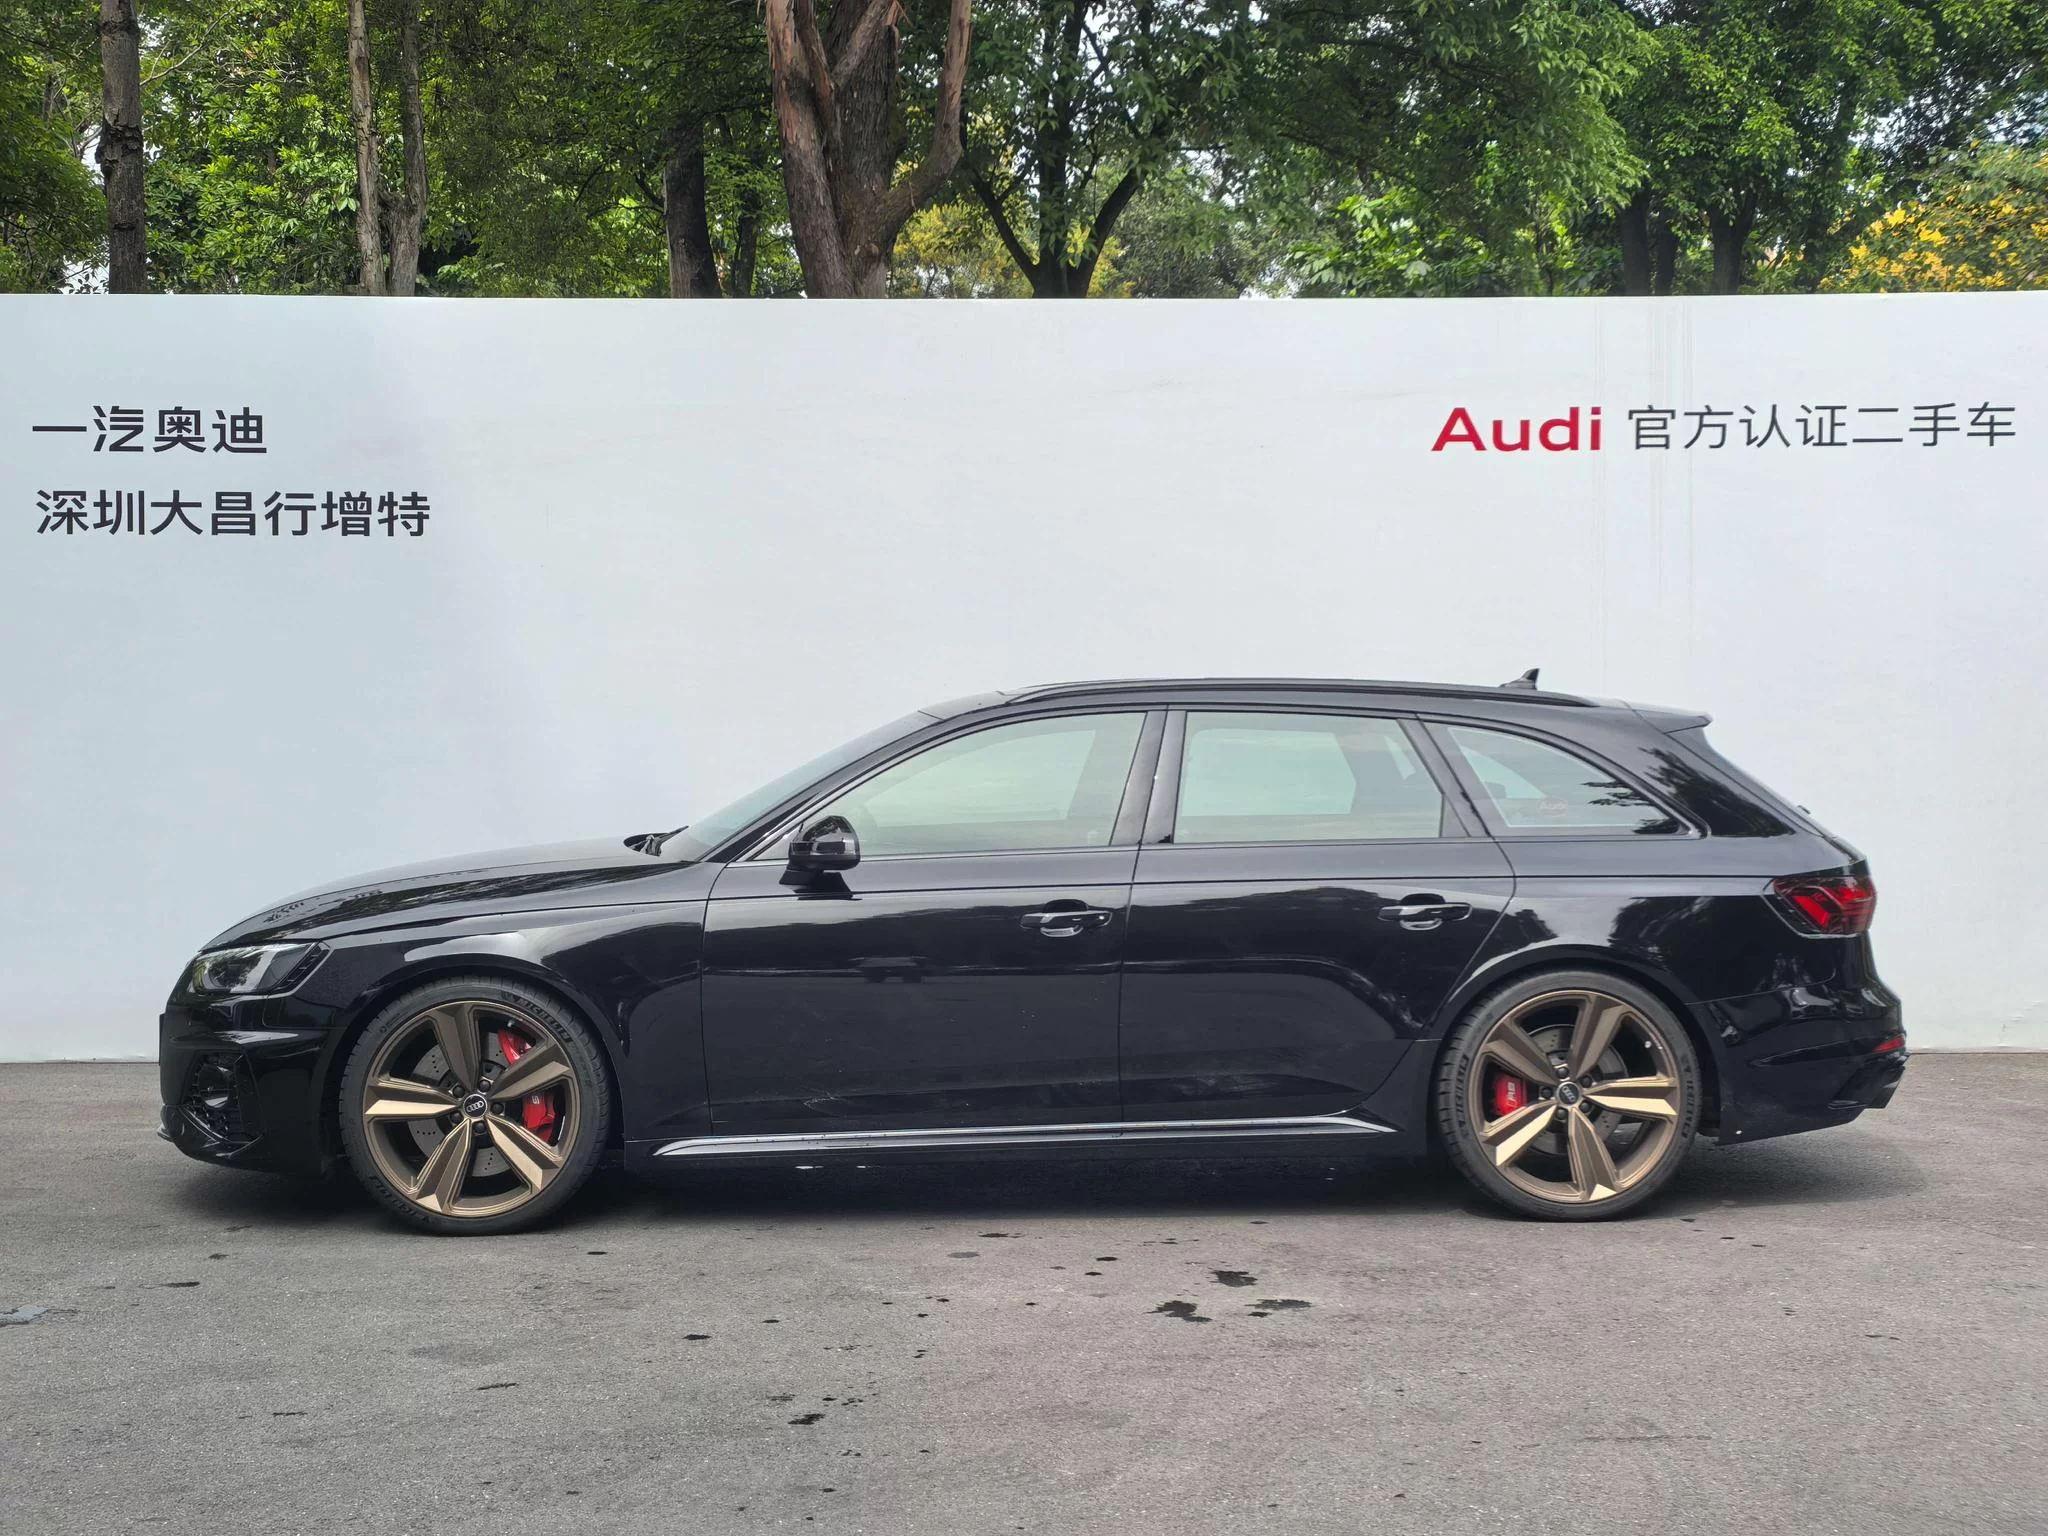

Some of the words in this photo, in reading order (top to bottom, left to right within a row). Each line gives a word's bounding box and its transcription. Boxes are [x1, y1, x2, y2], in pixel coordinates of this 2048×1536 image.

[32, 406, 267, 453] 一汽奥迪
[1432, 407, 1601, 452] Audi
[1628, 402, 2016, 450] 官方认证二手车
[36, 490, 430, 536] 深圳大昌行增特
